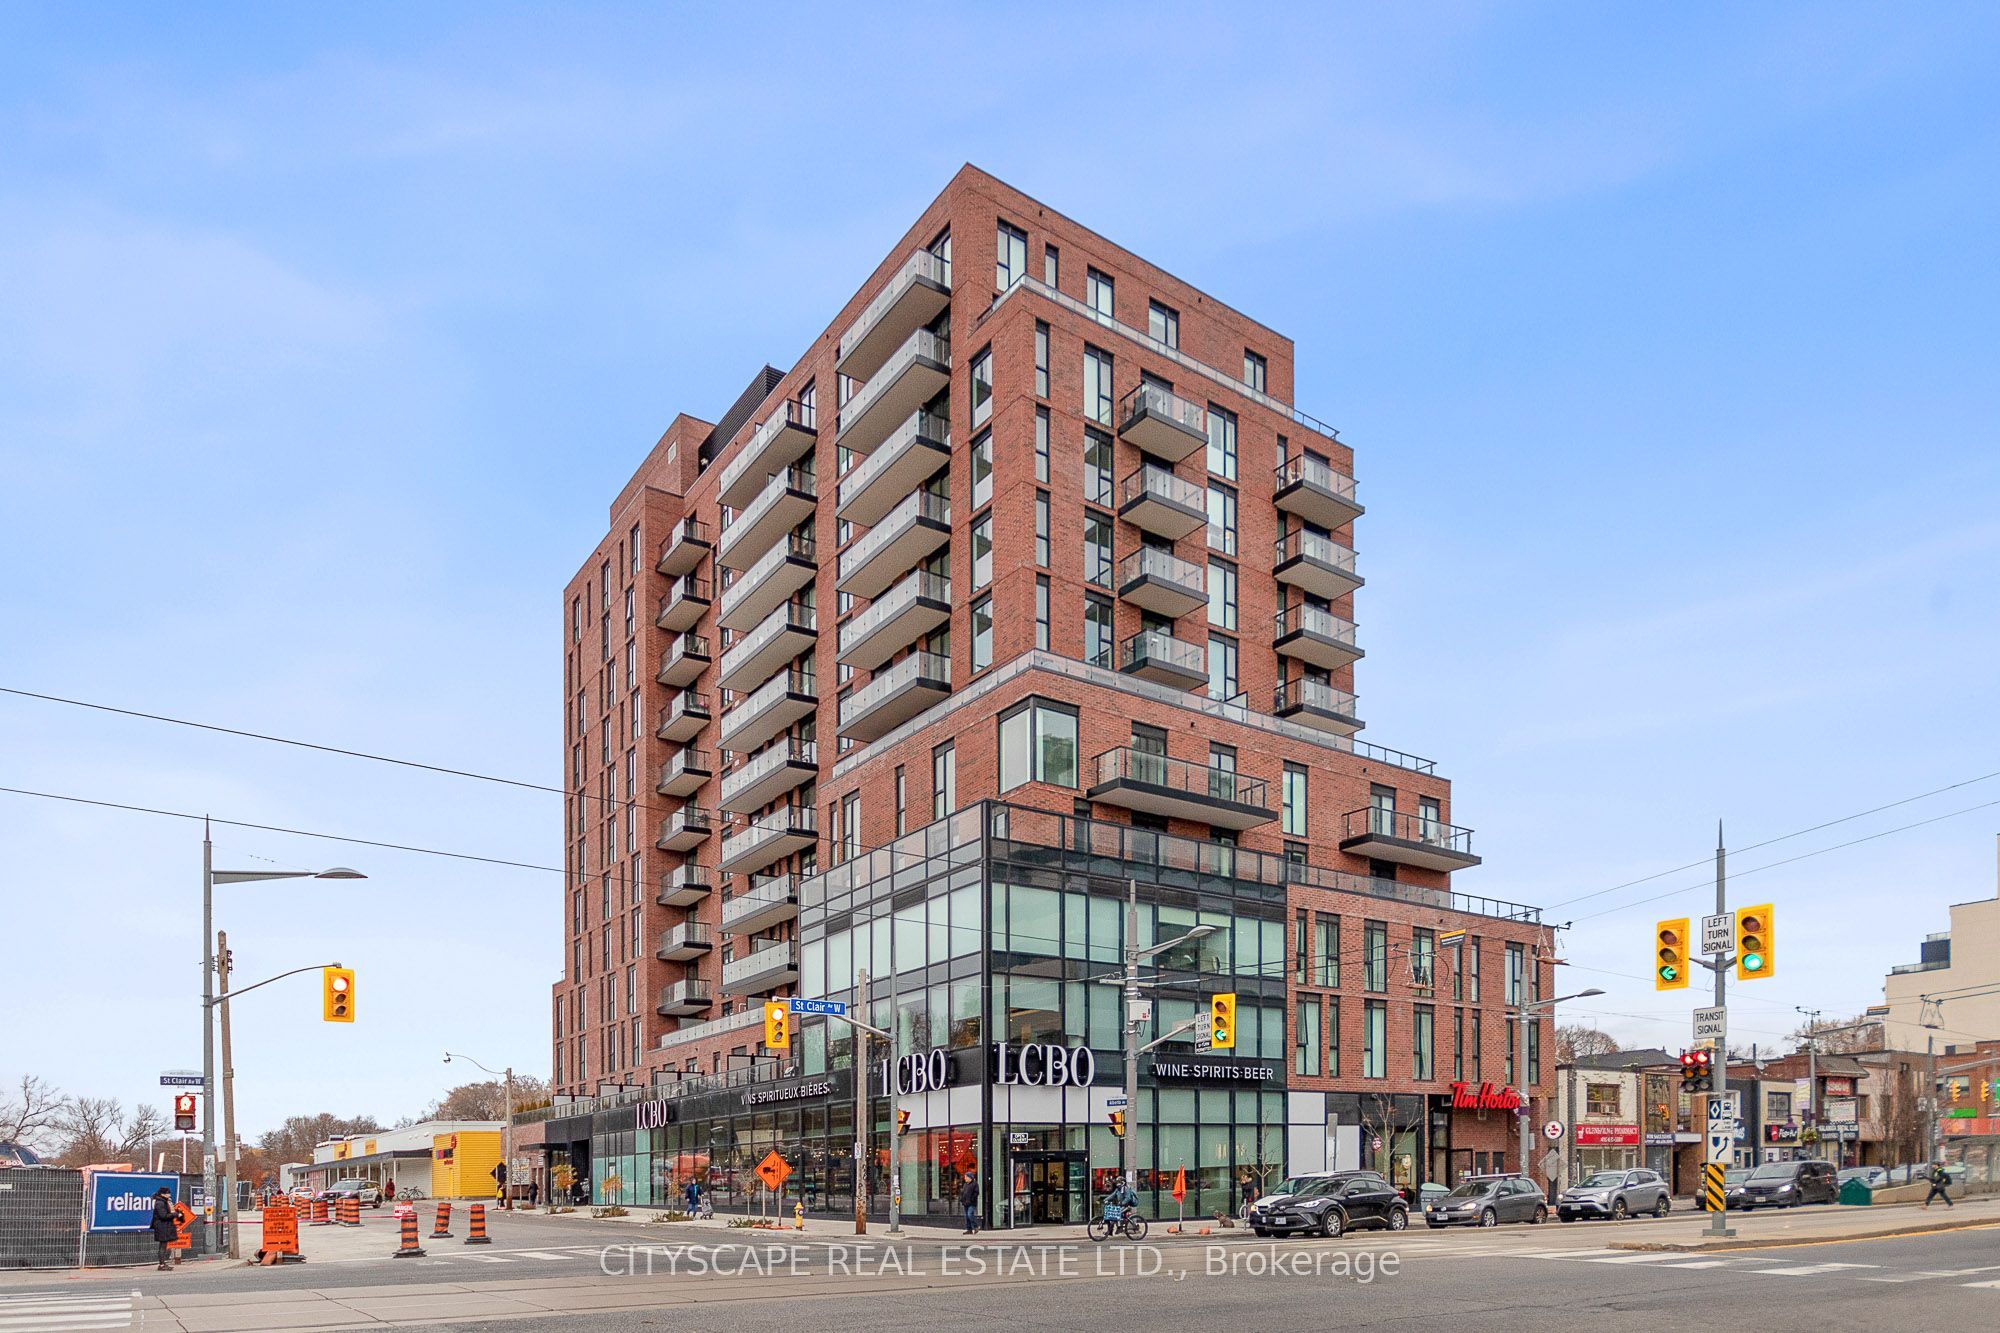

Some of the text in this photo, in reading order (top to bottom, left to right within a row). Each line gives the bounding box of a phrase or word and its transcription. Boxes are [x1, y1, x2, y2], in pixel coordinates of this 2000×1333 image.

[1707, 917, 1728, 928] LEFT
[1707, 928, 1729, 939] TURN
[1703, 940, 1732, 952] SIGNAL
[795, 1001, 804, 1011] St
[806, 1002, 826, 1012] Clair
[834, 1004, 841, 1013] W
[1197, 1013, 1210, 1023] LEFT
[1695, 1010, 1724, 1022] TRANSIT
[1197, 1023, 1211, 1032] TURN
[1697, 1024, 1722, 1035] SIGNAL
[1196, 1031, 1211, 1041] SIGNAL
[997, 1042, 1095, 1088] LCBO
[882, 1049, 947, 1098] LCBO
[1155, 1063, 1274, 1080] WINE SPIRITS BEER
[740, 1081, 829, 1106] VINS SPIRITUEUX BIÈRES
[1451, 1080, 1520, 1109] Tim Horto
[635, 1099, 668, 1130] LCBO
[106, 1192, 155, 1211] relian
